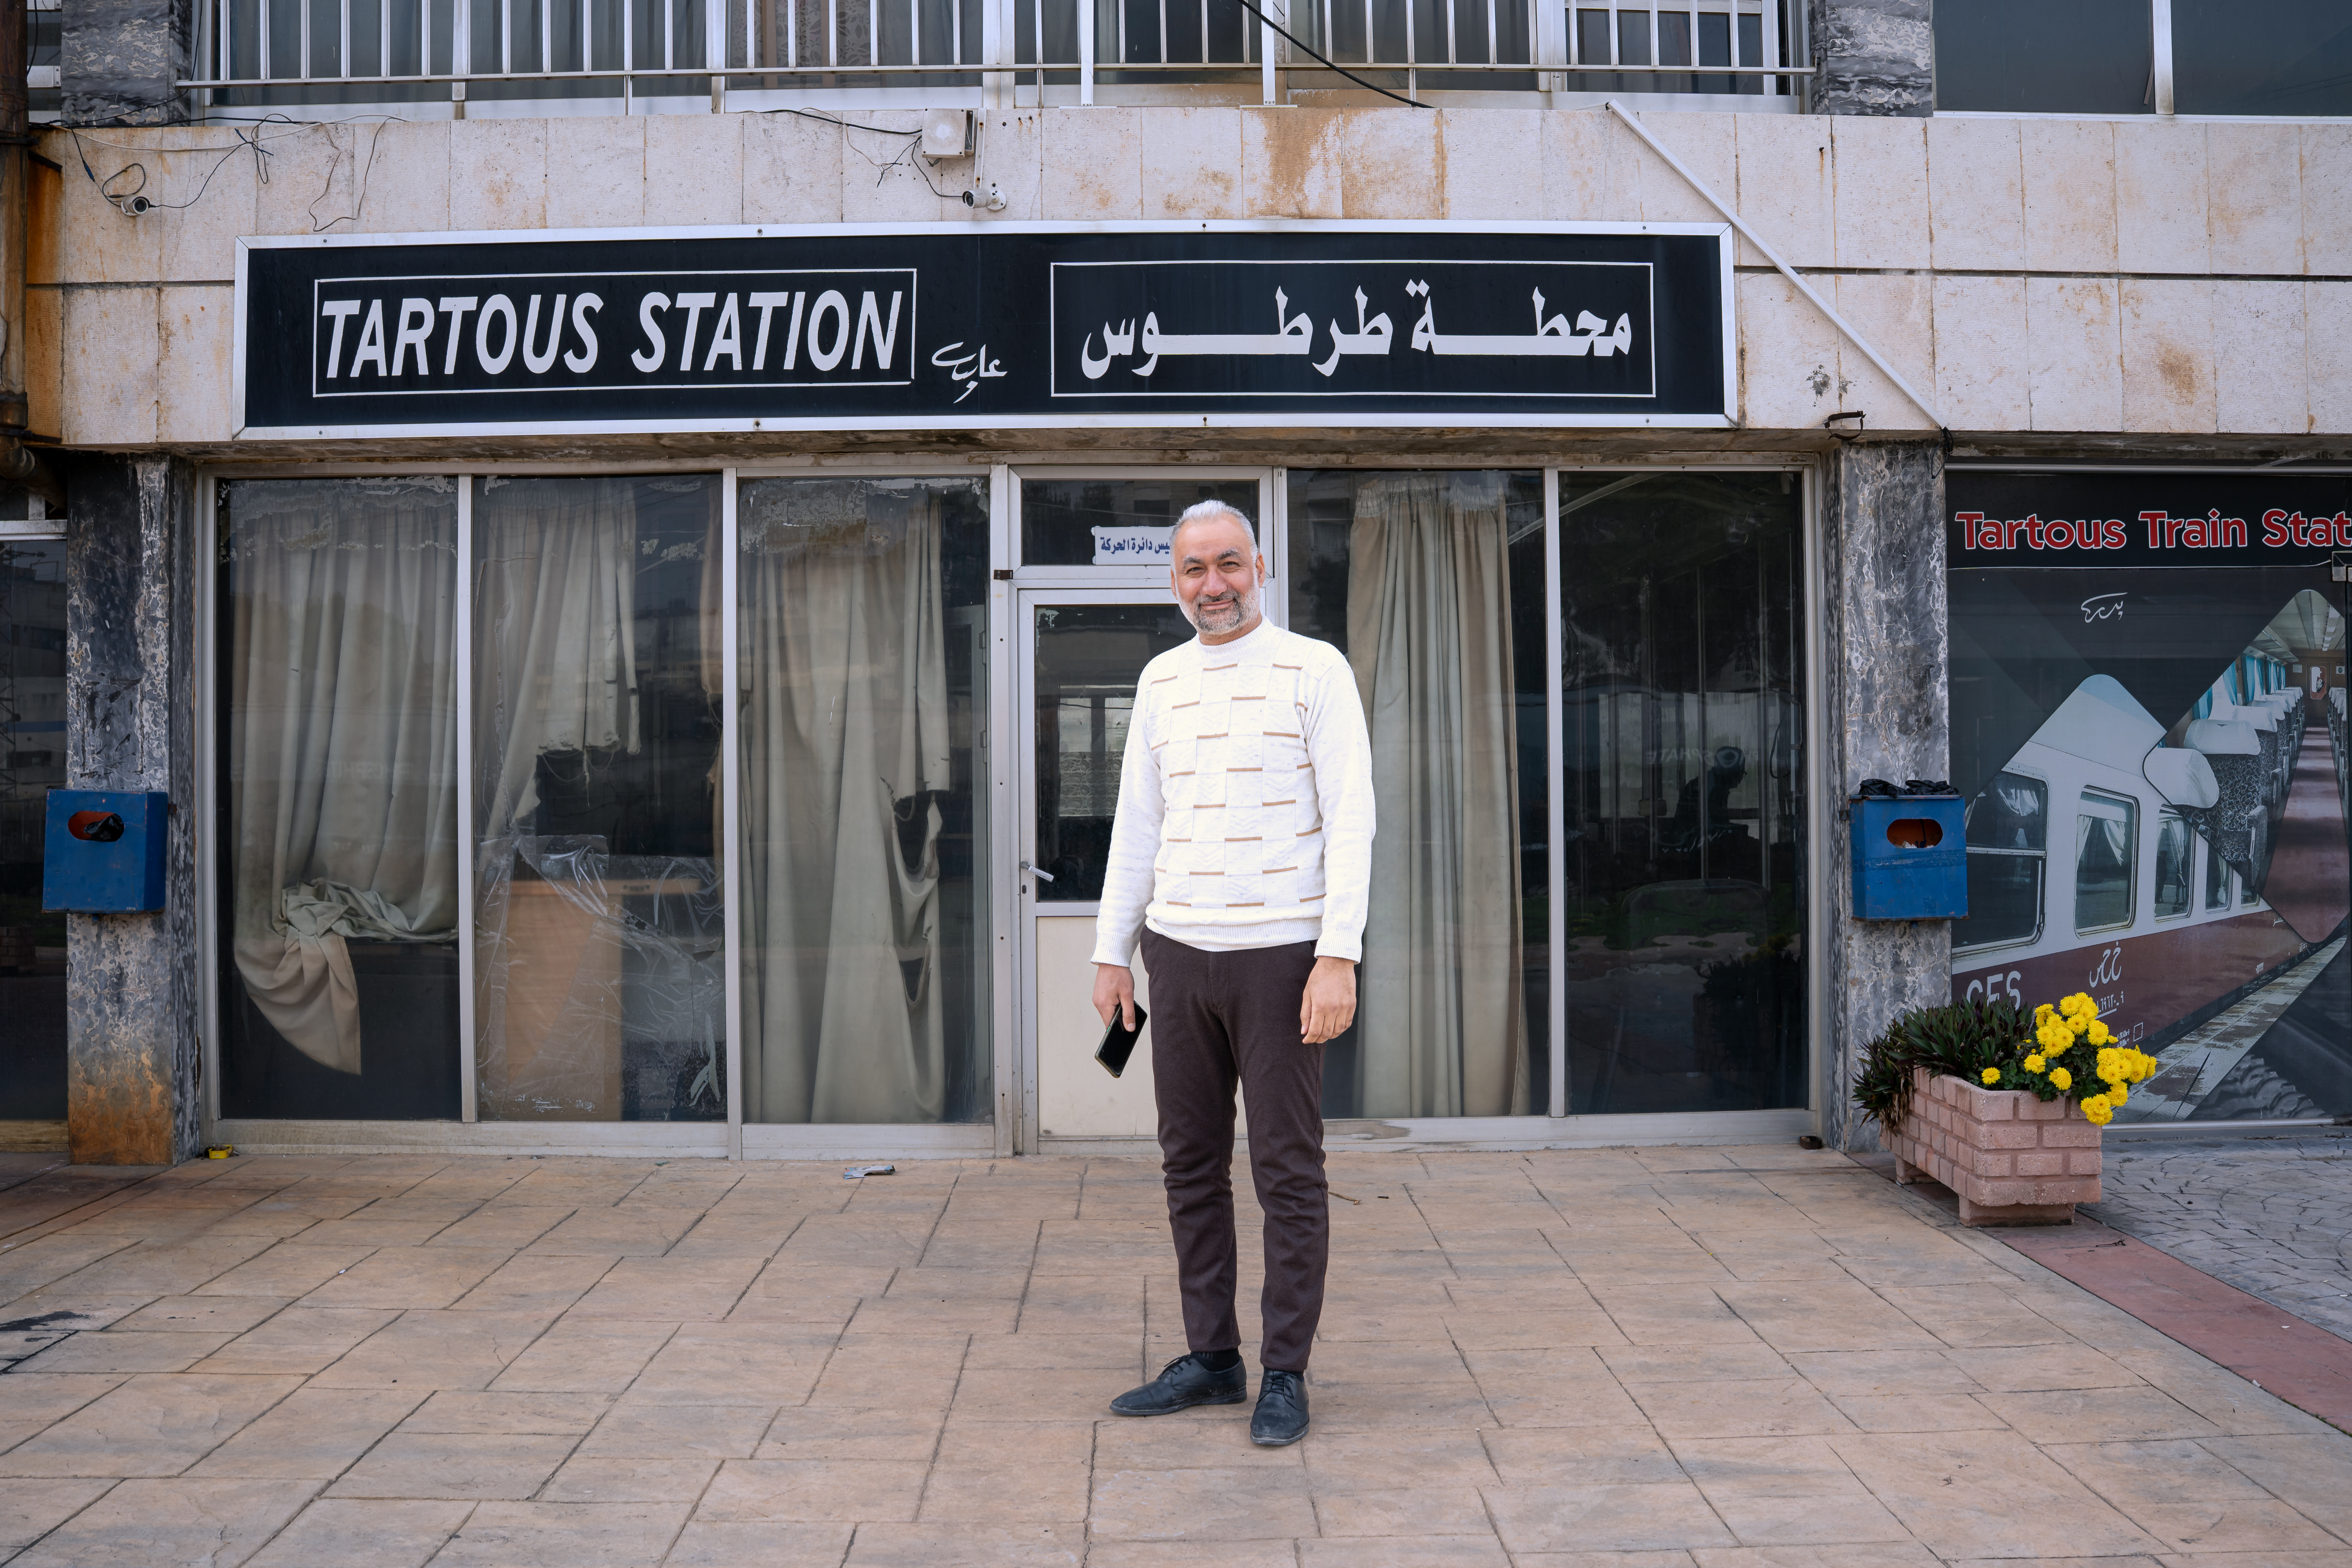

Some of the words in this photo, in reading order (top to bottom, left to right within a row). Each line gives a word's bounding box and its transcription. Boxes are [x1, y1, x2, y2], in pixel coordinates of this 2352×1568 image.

[322, 293, 603, 378] TARTOUS
[632, 290, 902, 372] STATION
[1082, 285, 1393, 379] طرطوس
[1405, 279, 1631, 356] محطة
[1100, 537, 1129, 555] الحركة
[1131, 537, 1152, 554] دائرة
[1955, 512, 2126, 550] Tartous
[2138, 508, 2247, 548] Train
[2262, 509, 2352, 547] Stat
